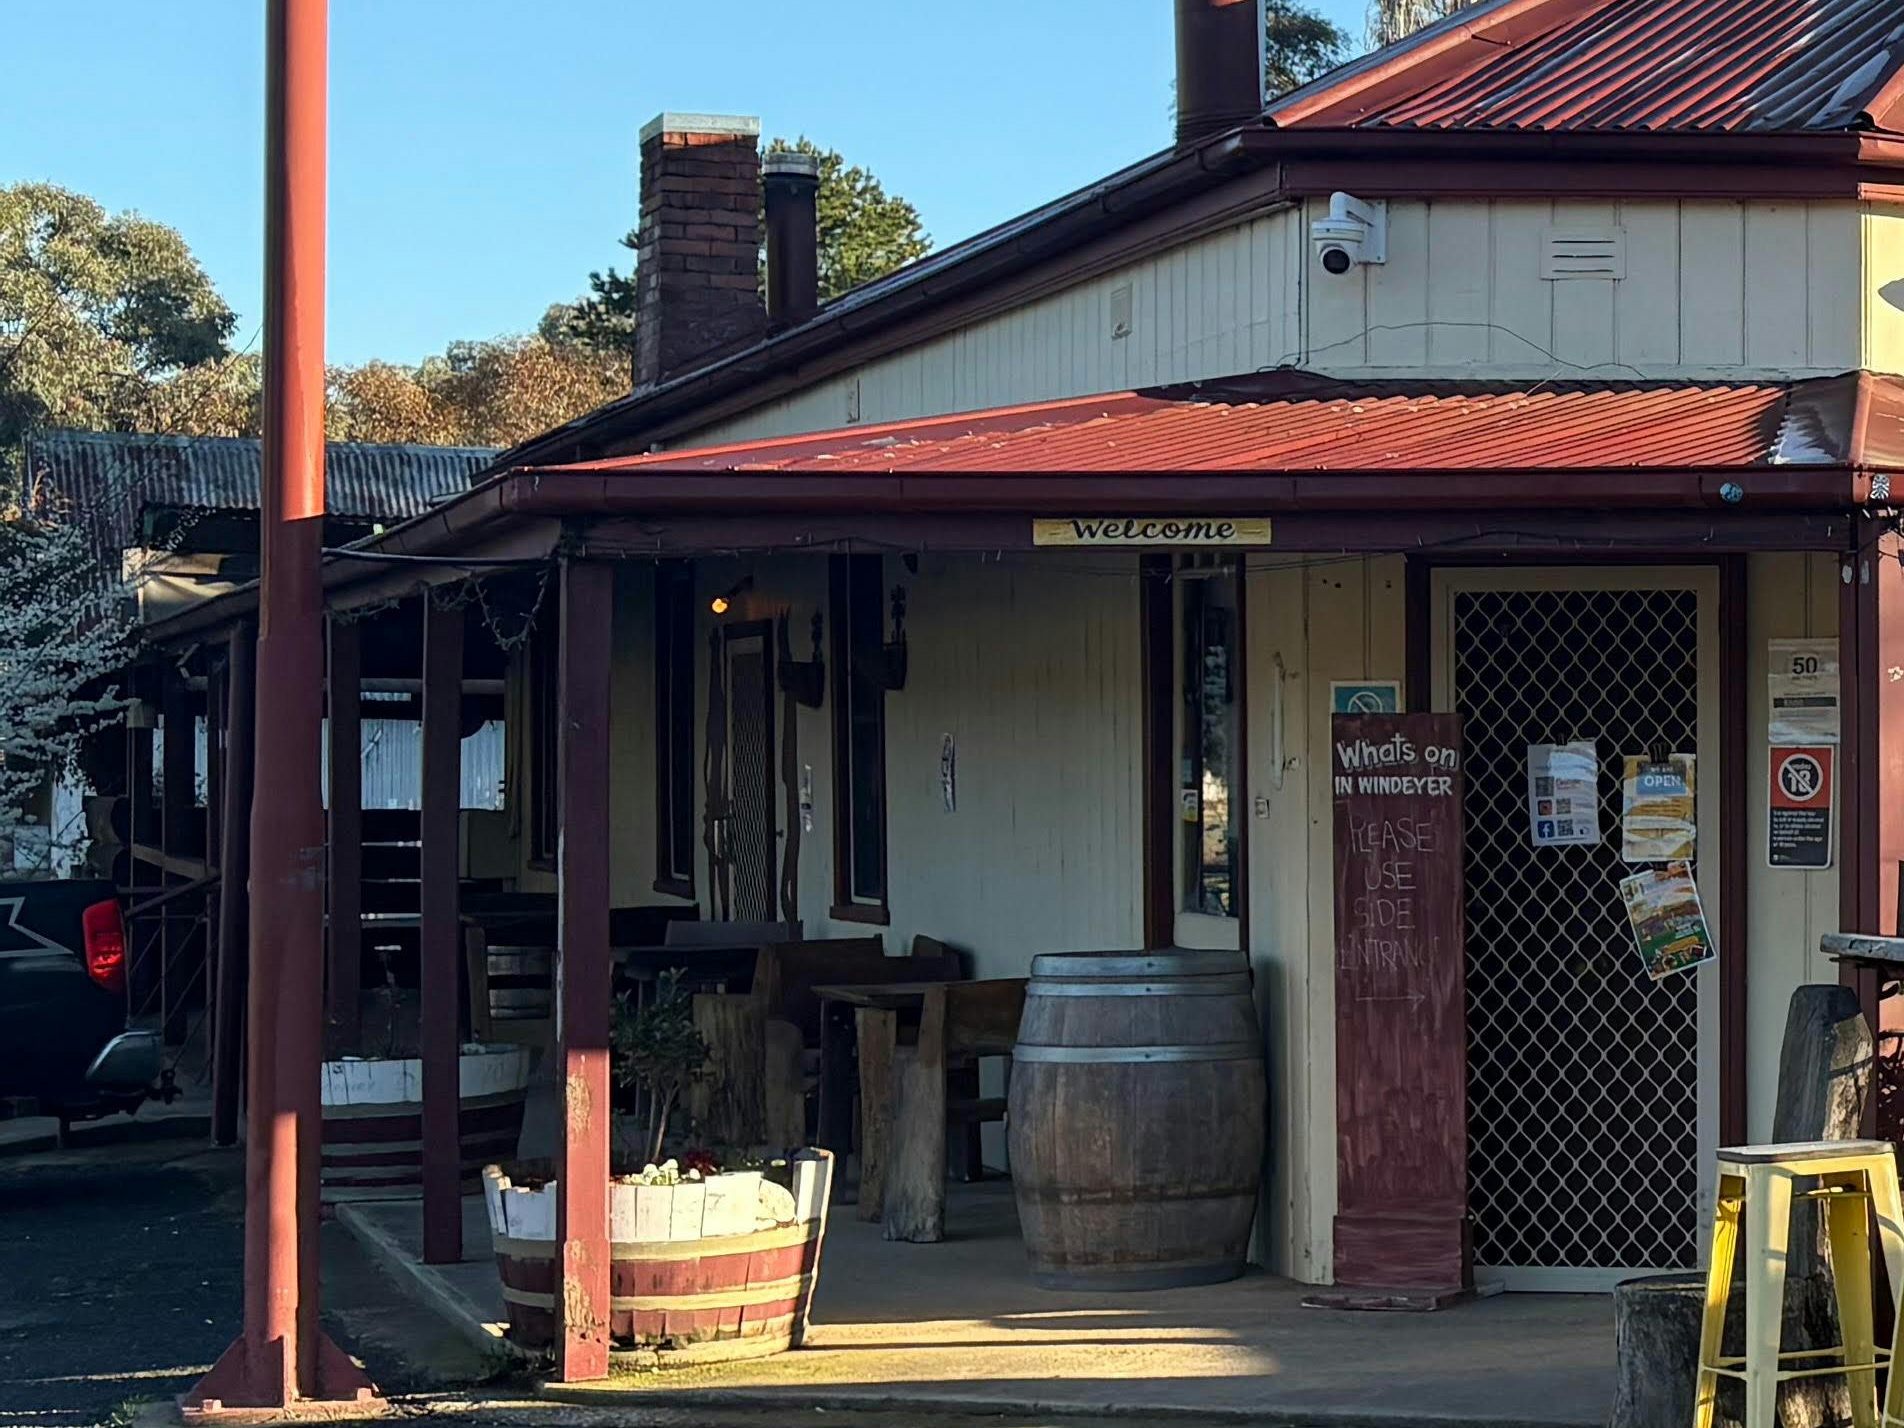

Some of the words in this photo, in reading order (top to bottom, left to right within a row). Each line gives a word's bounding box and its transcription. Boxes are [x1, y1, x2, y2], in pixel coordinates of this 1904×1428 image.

[1069, 519, 1236, 540] Welcome
[1792, 656, 1818, 675] 50
[1336, 732, 1416, 772] Whats
[1424, 744, 1460, 772] on
[1335, 776, 1352, 796] IN
[1357, 776, 1453, 797] WINDEYER
[1644, 775, 1682, 787] OPEN
[1350, 818, 1435, 854] PLEASE
[1365, 861, 1417, 891] USE
[1353, 897, 1416, 930] SIDE
